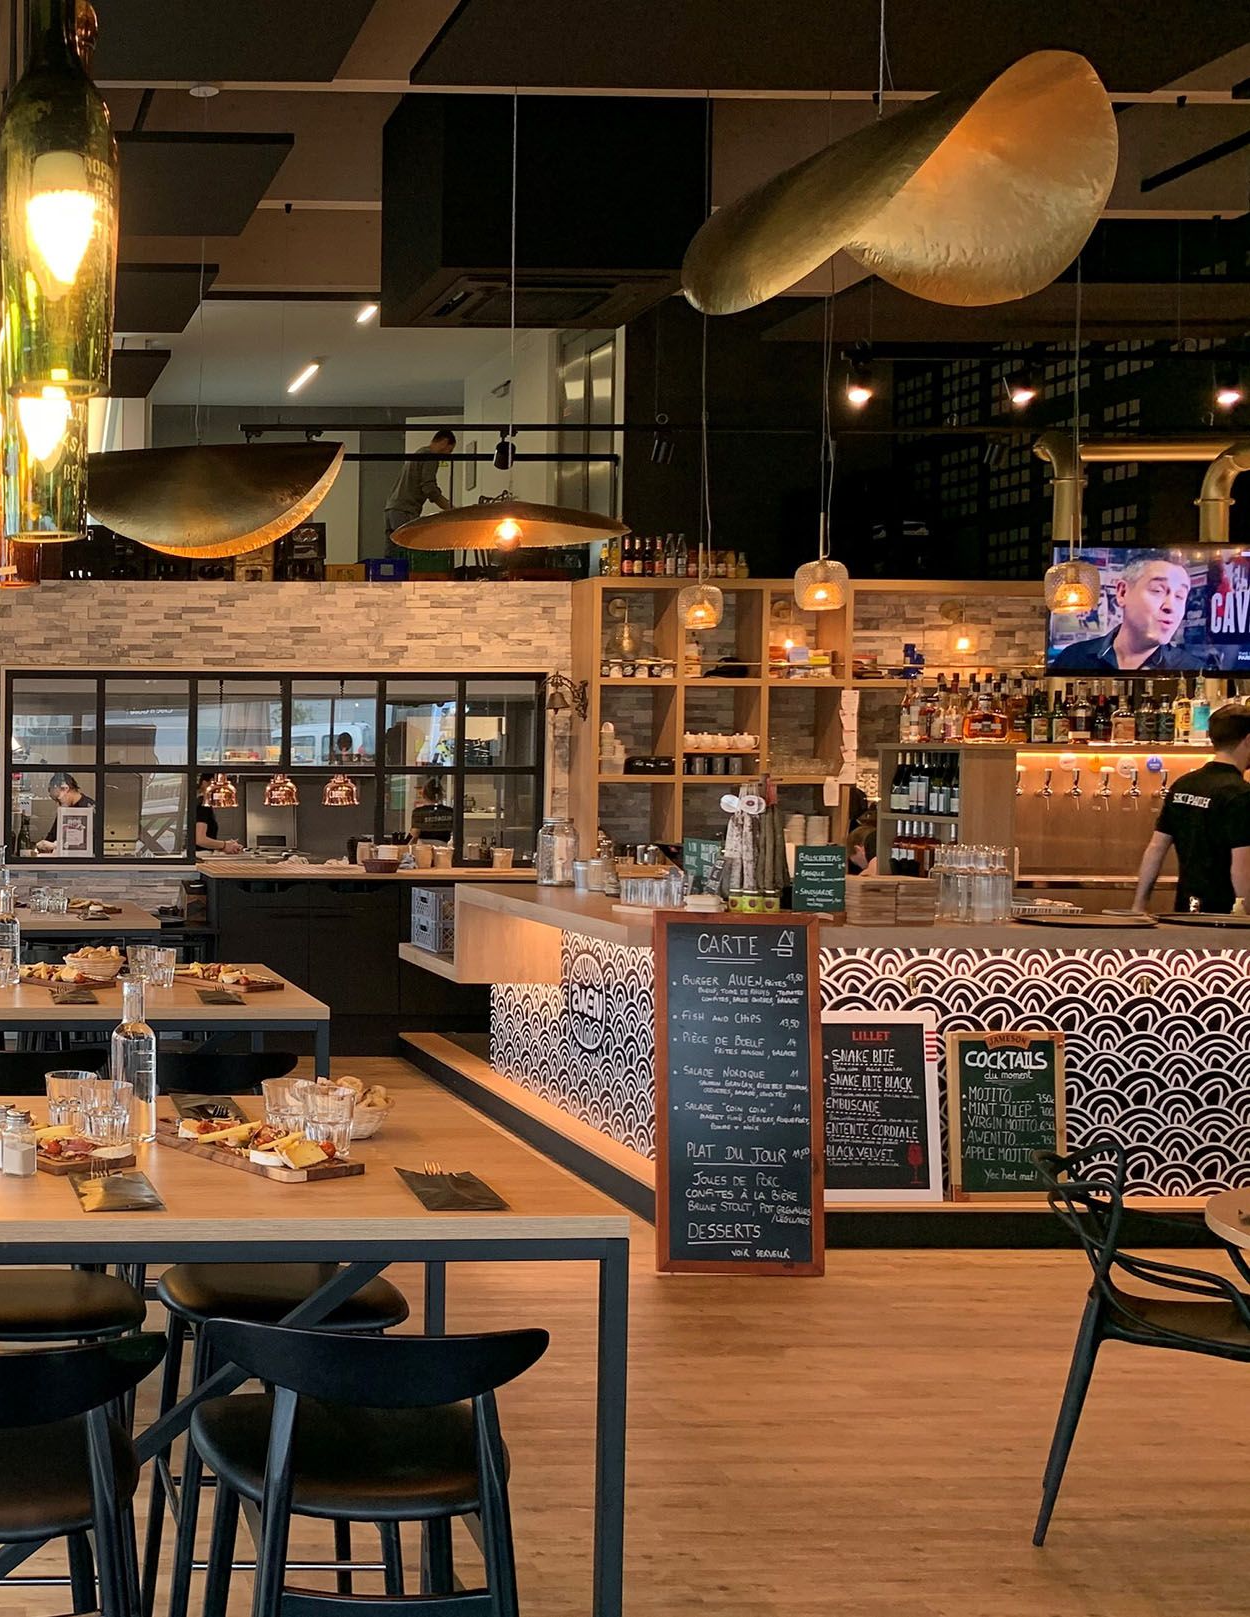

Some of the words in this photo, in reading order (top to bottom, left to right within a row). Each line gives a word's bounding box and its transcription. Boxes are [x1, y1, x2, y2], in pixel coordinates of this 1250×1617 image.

[1211, 591, 1250, 634] CAV
[697, 933, 758, 955] CARTE
[682, 974, 719, 986] BURGER
[779, 1019, 800, 1030] 13,50
[715, 1036, 728, 1046] DE
[852, 1030, 891, 1041] LILLET
[989, 1034, 1027, 1046] JAMESON
[831, 1049, 870, 1063] SNAKE
[872, 1049, 895, 1064] BITE
[965, 1050, 1048, 1070] COCKTAILS
[683, 1065, 714, 1078] SALADE
[722, 1066, 765, 1079] NORDIQUE
[984, 1069, 999, 1080] du
[1001, 1070, 1034, 1080] moment
[830, 1073, 860, 1087] SNAKE
[862, 1075, 883, 1088] BITE
[885, 1076, 912, 1090] BLACK
[968, 1086, 1011, 1103] MOJITO
[684, 1102, 714, 1112] SALADE
[825, 1097, 880, 1114] EMBUSCADE
[968, 1102, 997, 1115] MINT
[1000, 1104, 1032, 1118] JULEP
[826, 1122, 869, 1136] ENTENTE
[871, 1124, 918, 1139] CORDIALE
[968, 1114, 1002, 1129] VIRGIN
[1006, 1118, 1037, 1132] MOJITO
[967, 1129, 1016, 1146] AWENITO
[686, 1142, 716, 1158] PLAT
[725, 1146, 744, 1160] DU
[750, 1147, 787, 1165] JOUR
[826, 1145, 854, 1157] BLACK
[856, 1146, 894, 1158] VELVET
[965, 1145, 995, 1160] APPLE
[692, 1171, 727, 1185] JOUES
[733, 1176, 746, 1186] DE
[756, 1172, 780, 1187] PORC
[754, 1191, 766, 1200] LA
[688, 1201, 717, 1212] BRUNE
[688, 1223, 761, 1239] DESSERTS
[755, 1248, 790, 1259] SERVEUR
